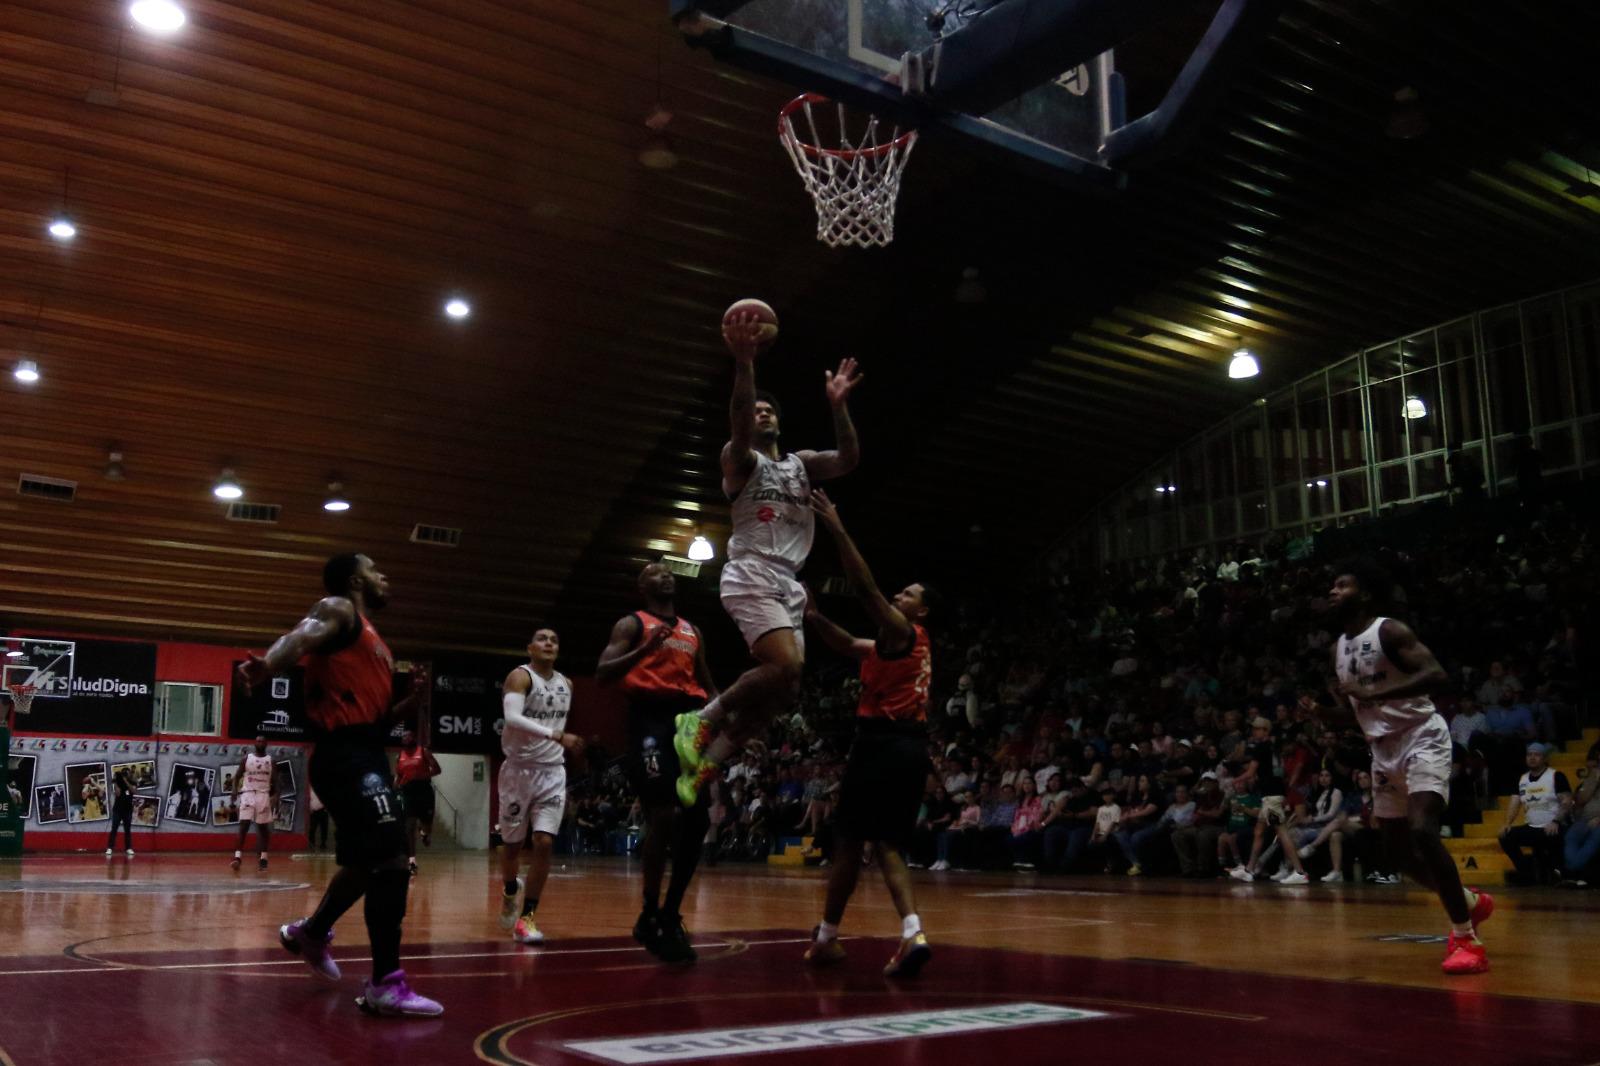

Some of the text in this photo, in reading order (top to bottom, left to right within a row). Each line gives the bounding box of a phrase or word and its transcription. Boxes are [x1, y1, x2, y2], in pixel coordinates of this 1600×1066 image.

[439, 715, 473, 734] SM
[373, 794, 391, 815] 11
[1466, 856, 1478, 869] A
[631, 1006, 1082, 1056] SaludDigna
